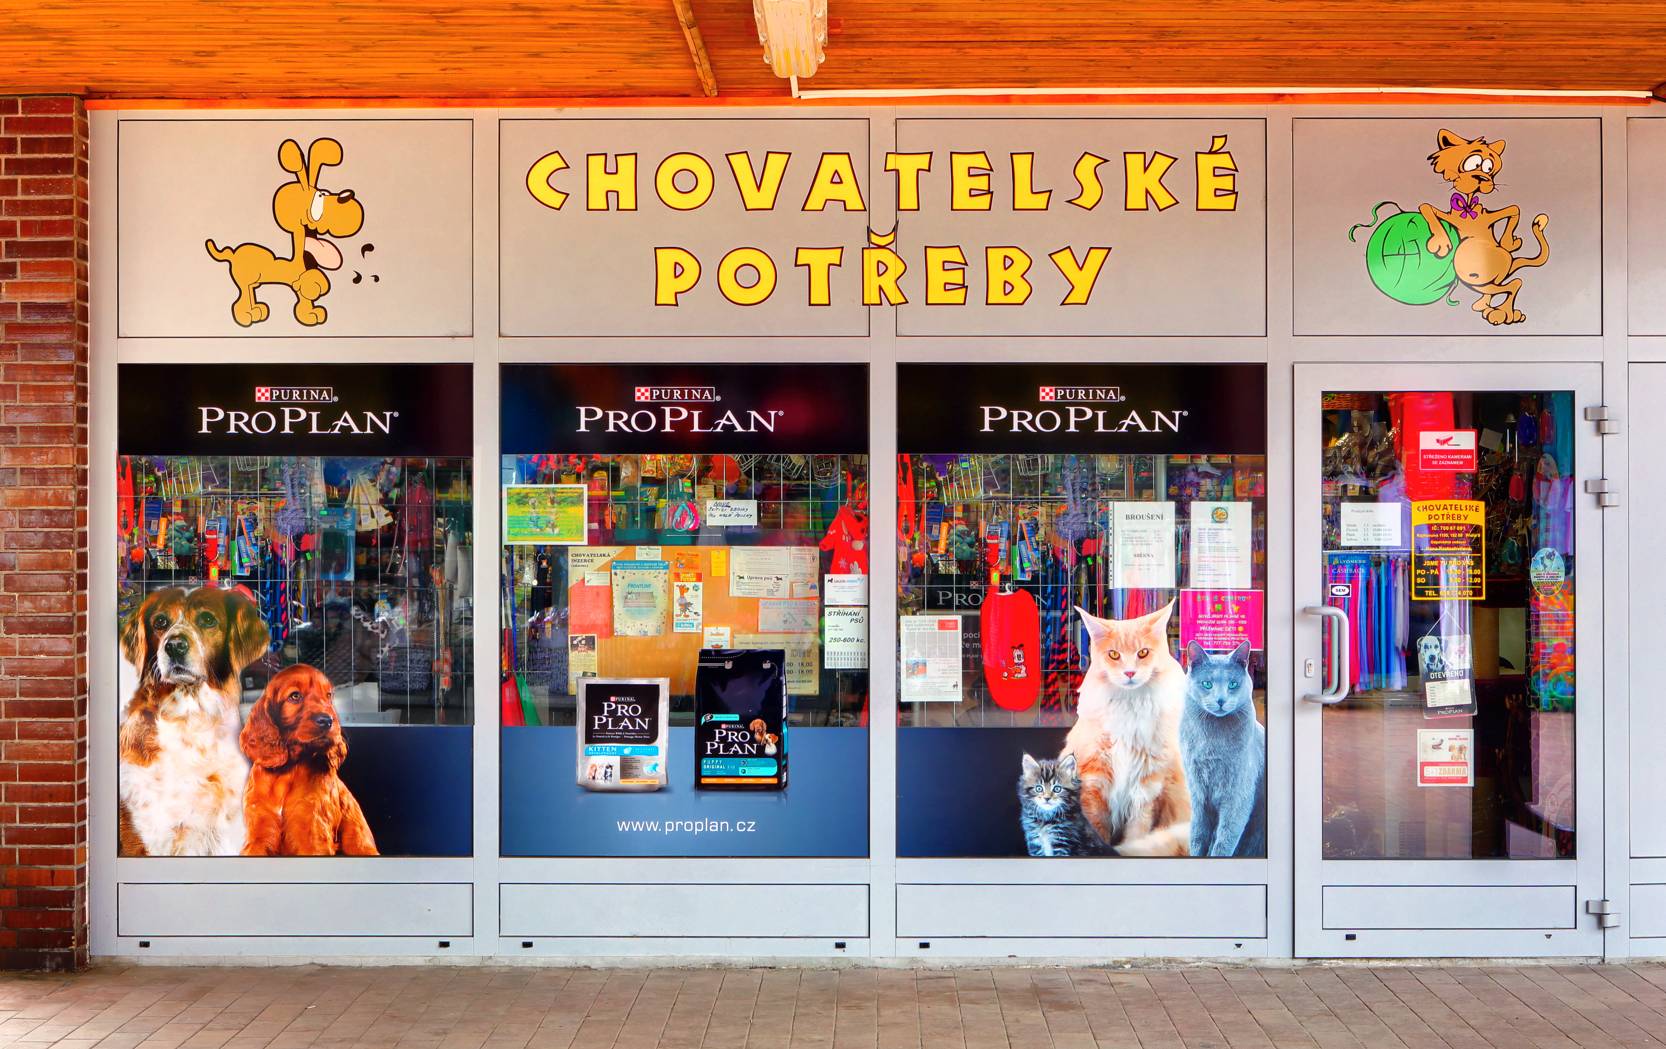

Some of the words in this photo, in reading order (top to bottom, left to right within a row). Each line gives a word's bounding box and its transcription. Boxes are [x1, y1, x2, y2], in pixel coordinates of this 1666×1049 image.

[525, 135, 1239, 211] CHOVATELSKÉ
[654, 221, 1112, 306] POTŘEBY
[272, 389, 330, 400] PURINA
[652, 389, 712, 400] PURINA
[1056, 389, 1117, 400] PURINA
[1416, 503, 1480, 513] CHOVATELSKÉ
[1125, 512, 1164, 521] BROUŠENÍ
[1427, 512, 1469, 521] POTŘEBY
[827, 609, 861, 617] STŘÍHÁNÍ
[849, 616, 864, 624] PSŮ
[1429, 669, 1464, 679] OTEVŘENO
[602, 702, 642, 716] PRO
[593, 715, 650, 730] PLAN
[714, 729, 750, 742] PRO
[705, 741, 758, 755] PLAN
[616, 818, 756, 835] www.proplan.cz
